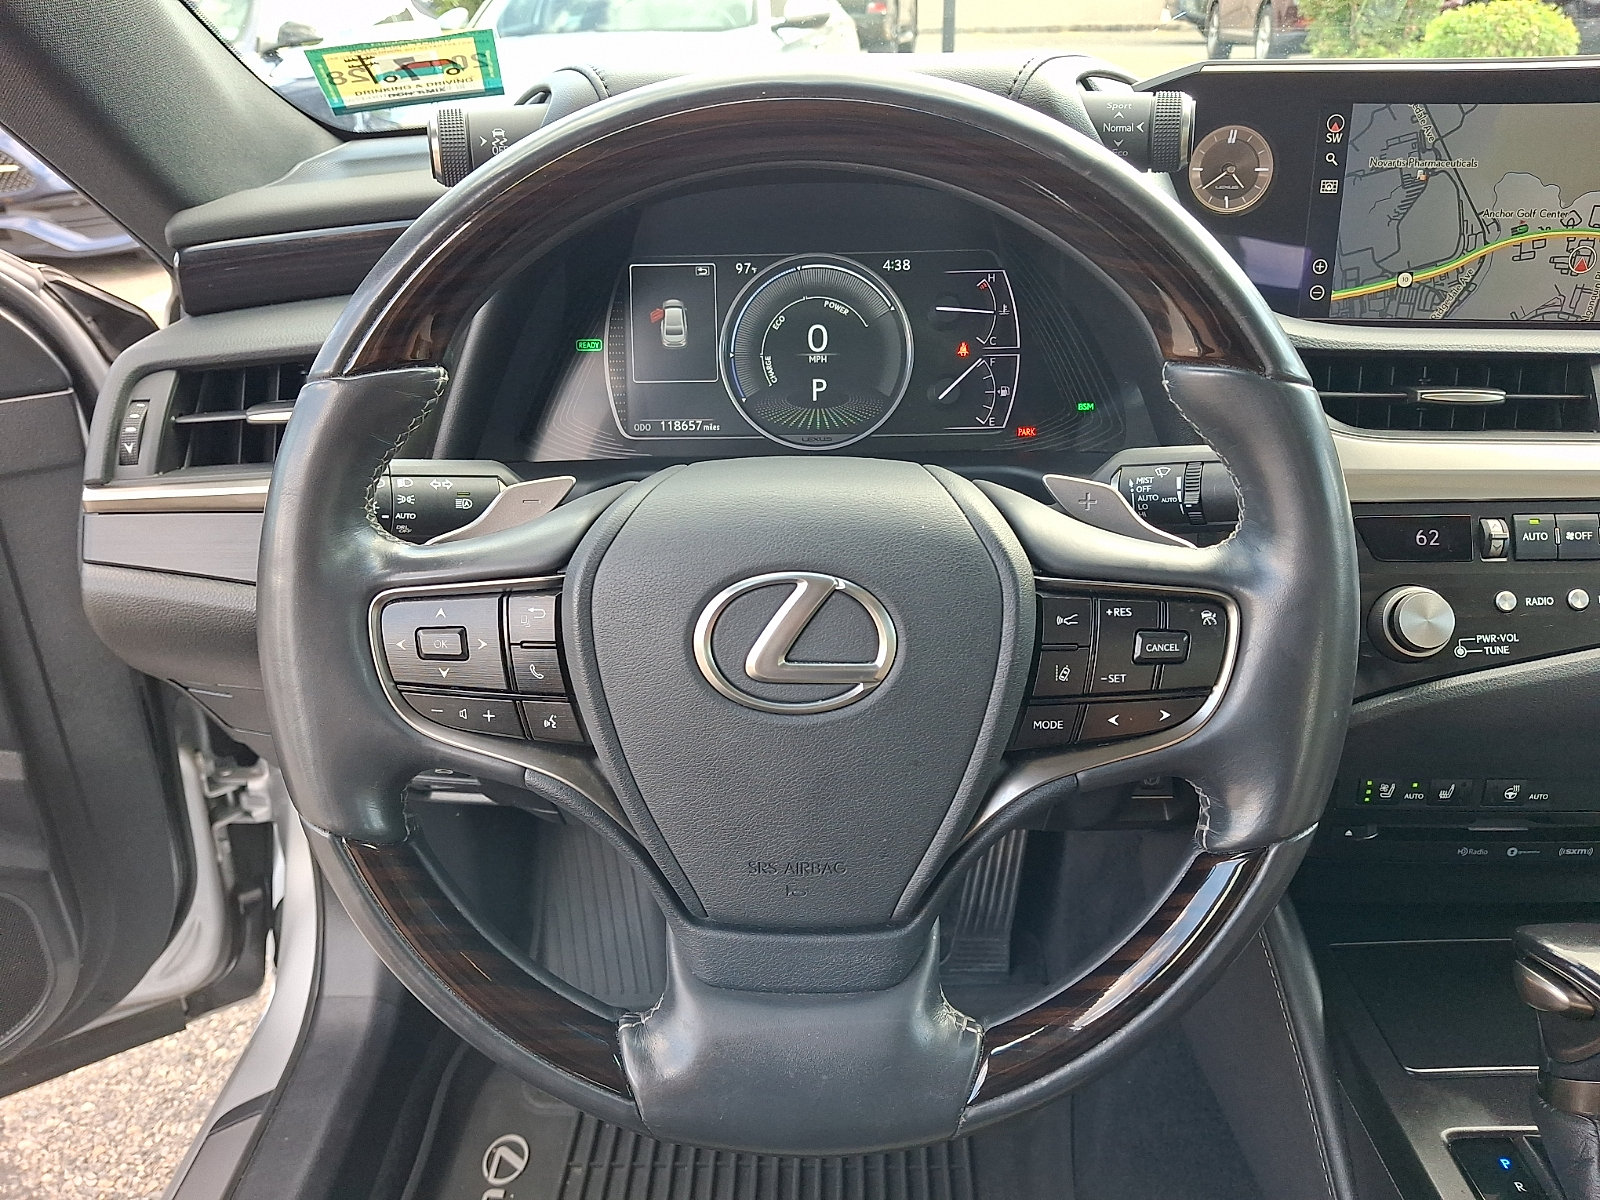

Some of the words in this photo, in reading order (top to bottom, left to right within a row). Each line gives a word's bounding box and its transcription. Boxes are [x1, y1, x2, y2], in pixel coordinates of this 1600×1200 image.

[355, 85, 412, 97] DRINKING
[426, 77, 474, 88] DRIVING
[1106, 102, 1133, 111] Sport
[1103, 122, 1134, 133] Normal
[1325, 132, 1343, 143] SW
[1423, 124, 1436, 142] Ave
[1369, 157, 1406, 168] Novartis
[1407, 157, 1478, 168] Pharmaceuticals
[1483, 209, 1514, 218] Anchor
[1516, 209, 1537, 218] Golf
[1539, 209, 1569, 218] Center
[882, 259, 911, 272] 4:38
[988, 273, 996, 283] H
[1430, 285, 1462, 319] Ridgedale
[1459, 268, 1474, 286] Ave
[824, 300, 850, 316] POWER
[772, 315, 785, 331] ECO
[807, 324, 829, 353] 0
[989, 336, 997, 346] C
[578, 341, 600, 349] READY
[808, 355, 828, 363] MPH
[990, 357, 996, 367] F
[764, 355, 778, 384] CHARGE
[812, 378, 828, 402] P
[1077, 402, 1095, 411] BSM
[633, 423, 652, 432] ODO
[660, 420, 703, 432] 118657
[988, 417, 996, 427] E
[1017, 427, 1037, 436] PARK
[1136, 485, 1152, 493] OFF
[1415, 529, 1440, 546] 62
[1522, 532, 1548, 541] AUTO
[1575, 532, 1593, 540] OFF
[1525, 597, 1554, 606] RADIO
[434, 640, 447, 648] OK
[1145, 643, 1180, 652] CANCEL
[1483, 646, 1510, 655] TUNE
[1033, 720, 1064, 730] MODE
[748, 861, 779, 875] SRS
[783, 861, 847, 875] AIRBAG
[1500, 1158, 1510, 1169] P
[1513, 1182, 1527, 1192] R
